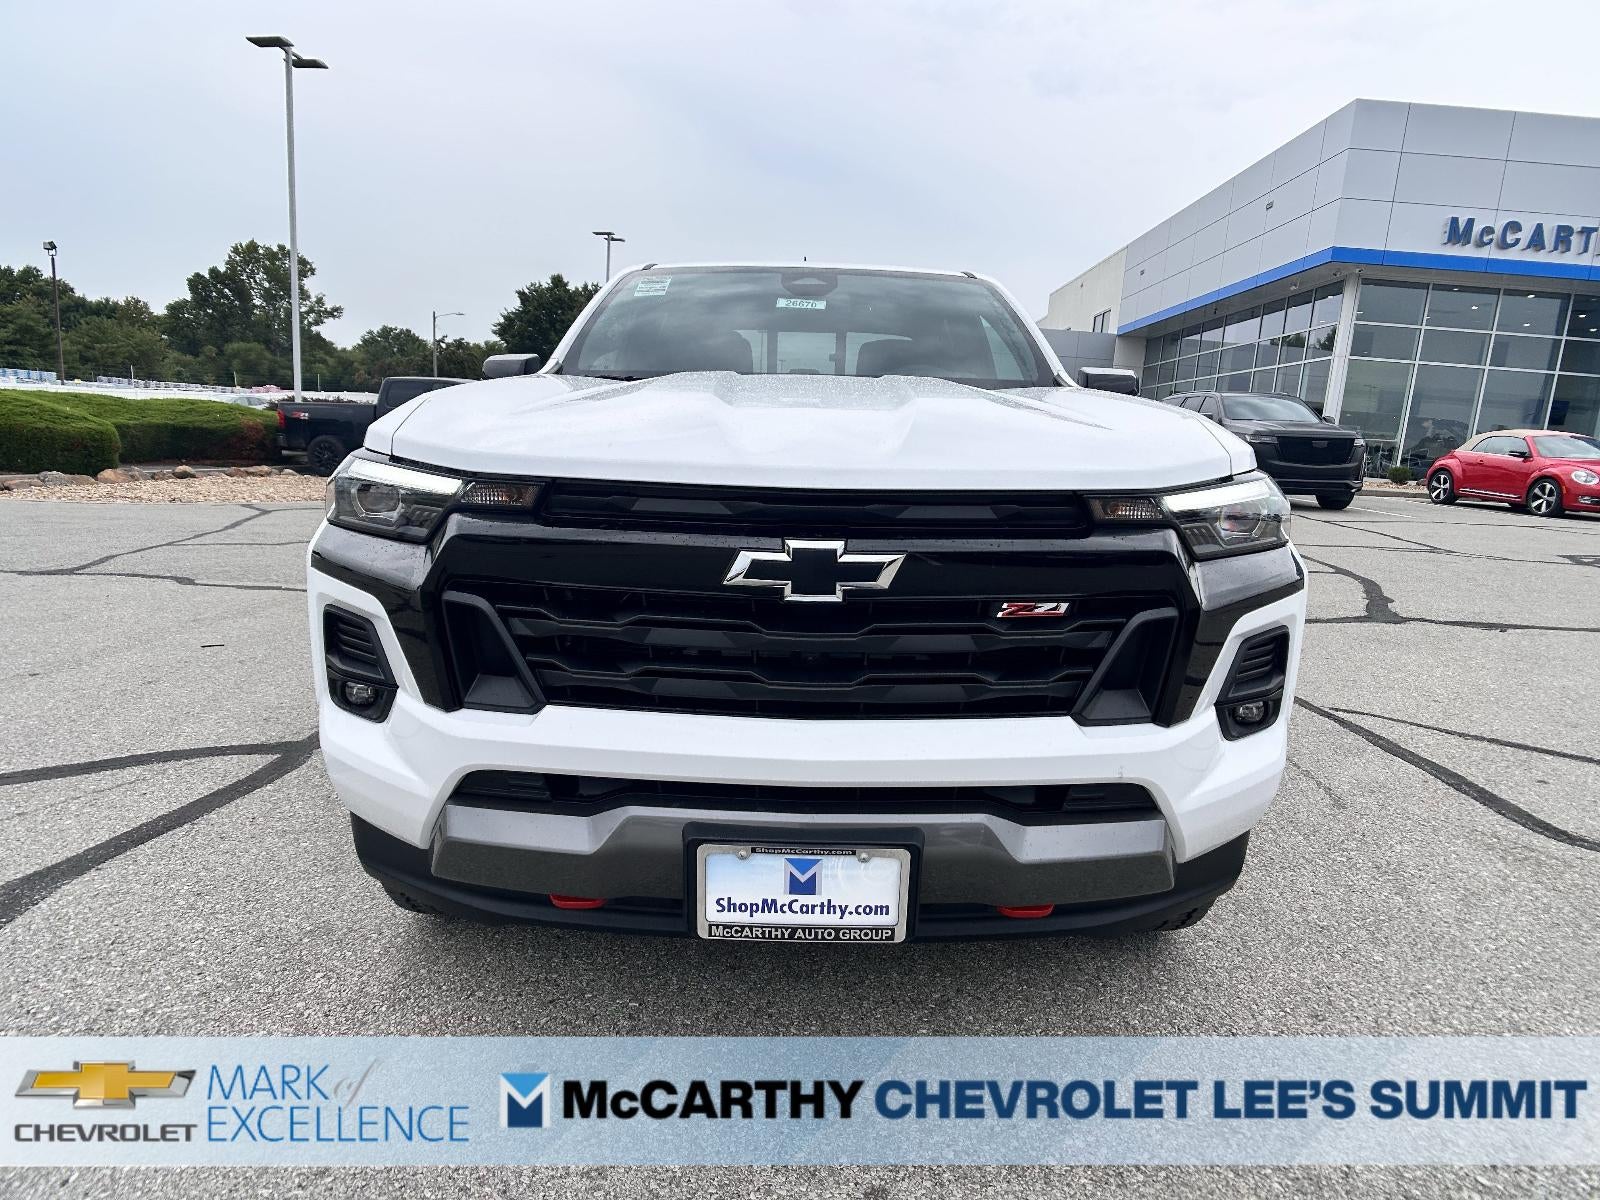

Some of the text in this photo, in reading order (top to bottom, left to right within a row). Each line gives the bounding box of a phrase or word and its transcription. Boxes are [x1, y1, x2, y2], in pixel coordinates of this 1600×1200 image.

[755, 847, 853, 856] ShopMcCarthy.com
[715, 897, 890, 919] ShopMcCarthy.com
[711, 925, 892, 940] McCARTHY AUTO GROUP
